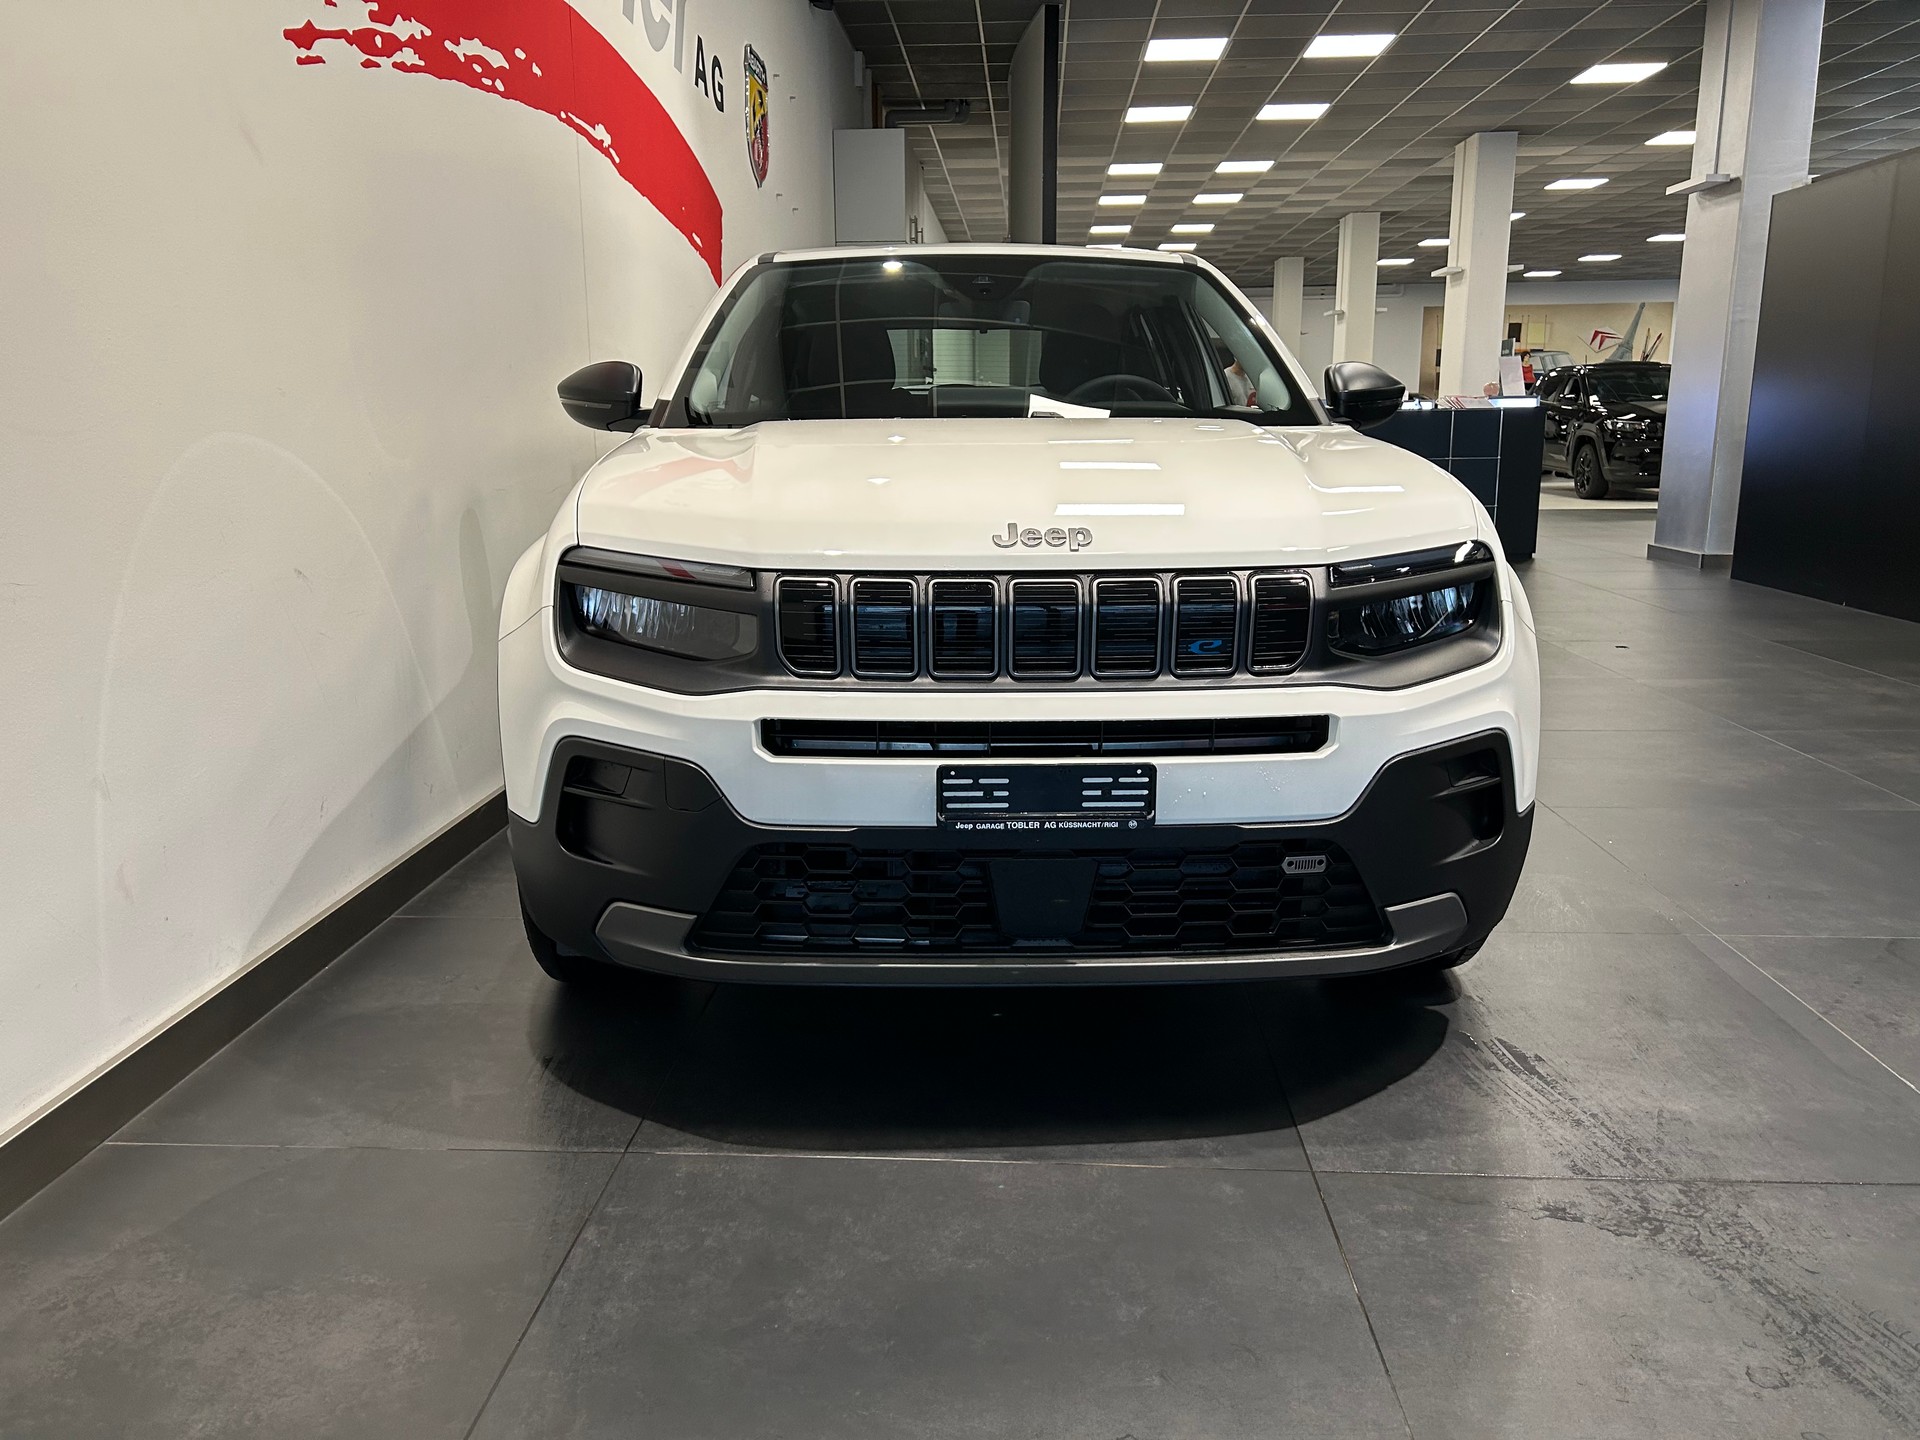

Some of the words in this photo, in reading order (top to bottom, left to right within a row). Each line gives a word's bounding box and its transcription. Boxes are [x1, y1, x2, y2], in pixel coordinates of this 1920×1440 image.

[694, 34, 725, 113] AG
[991, 522, 1093, 552] Jeep
[1188, 640, 1222, 654] e
[955, 822, 973, 830] Jeep
[1006, 821, 1040, 829] TOBLER
[1044, 821, 1057, 829] AG
[1058, 820, 1119, 828] KÜSSNACHT/RIGI
